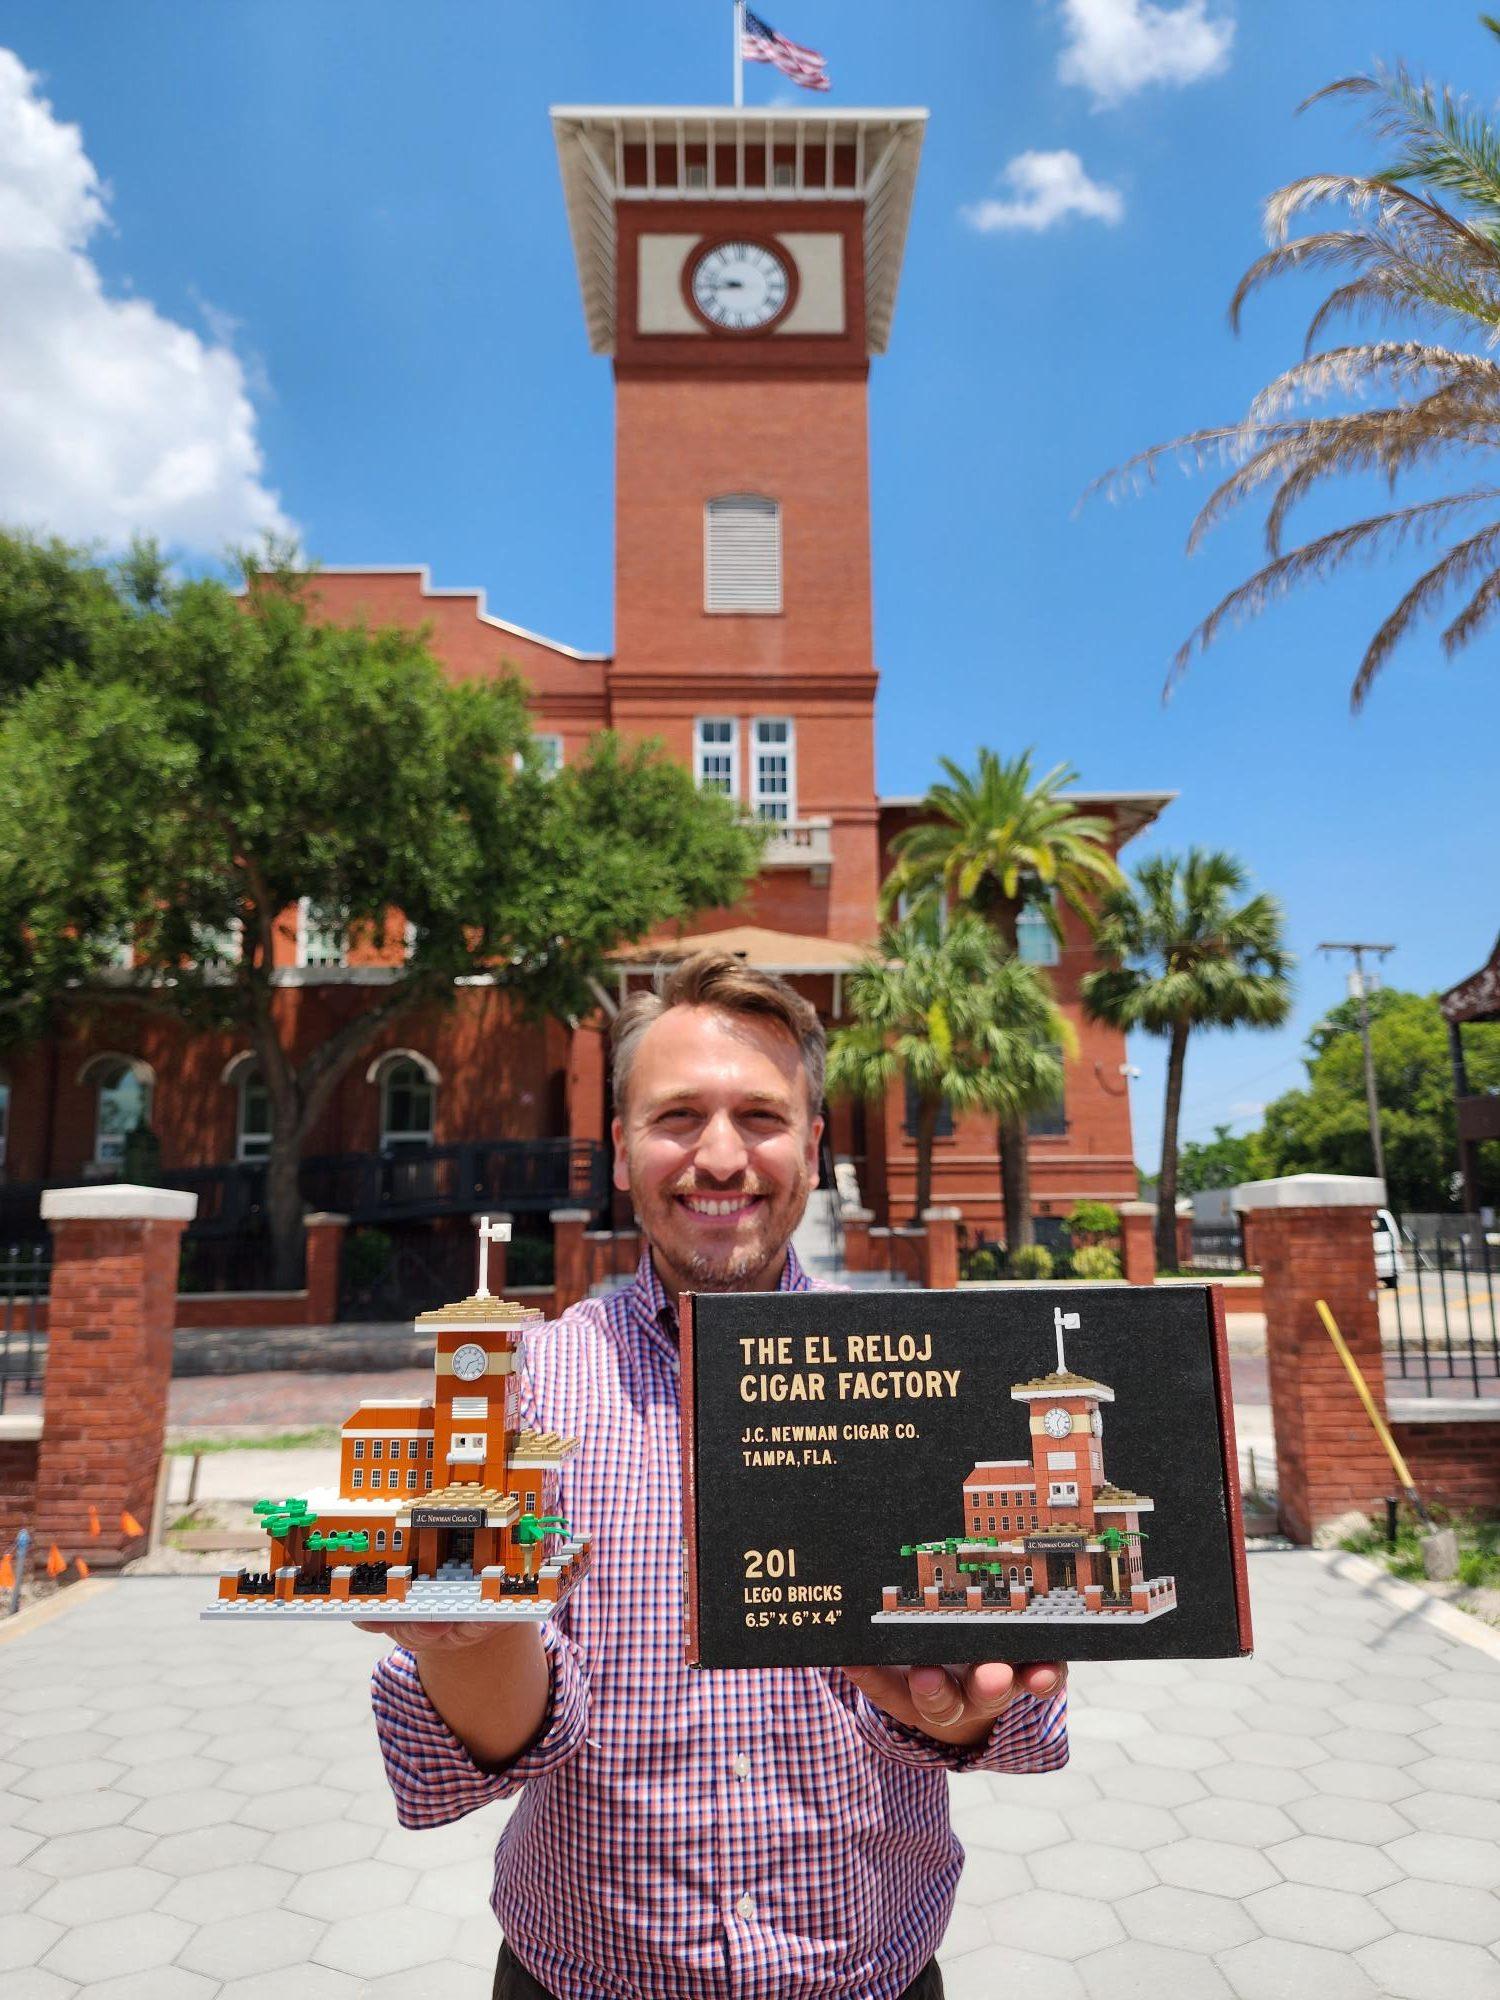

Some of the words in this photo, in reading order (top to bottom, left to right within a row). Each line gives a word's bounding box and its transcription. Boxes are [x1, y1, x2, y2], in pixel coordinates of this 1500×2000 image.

[739, 1338, 793, 1365] THE
[805, 1336, 837, 1364] EL
[847, 1334, 932, 1362] RELOJ
[740, 1373, 825, 1402] CIGAR
[838, 1370, 961, 1400] FACTORY
[741, 1427, 769, 1443] J.C.
[771, 1425, 838, 1442] NEWMAN
[843, 1424, 889, 1440] CIGAR
[895, 1423, 920, 1439] CO.
[743, 1450, 800, 1467] TAMPA,
[803, 1449, 837, 1465] FLA.
[743, 1548, 796, 1578] 201
[744, 1587, 782, 1604] LEGO
[788, 1585, 843, 1603] BRICKS
